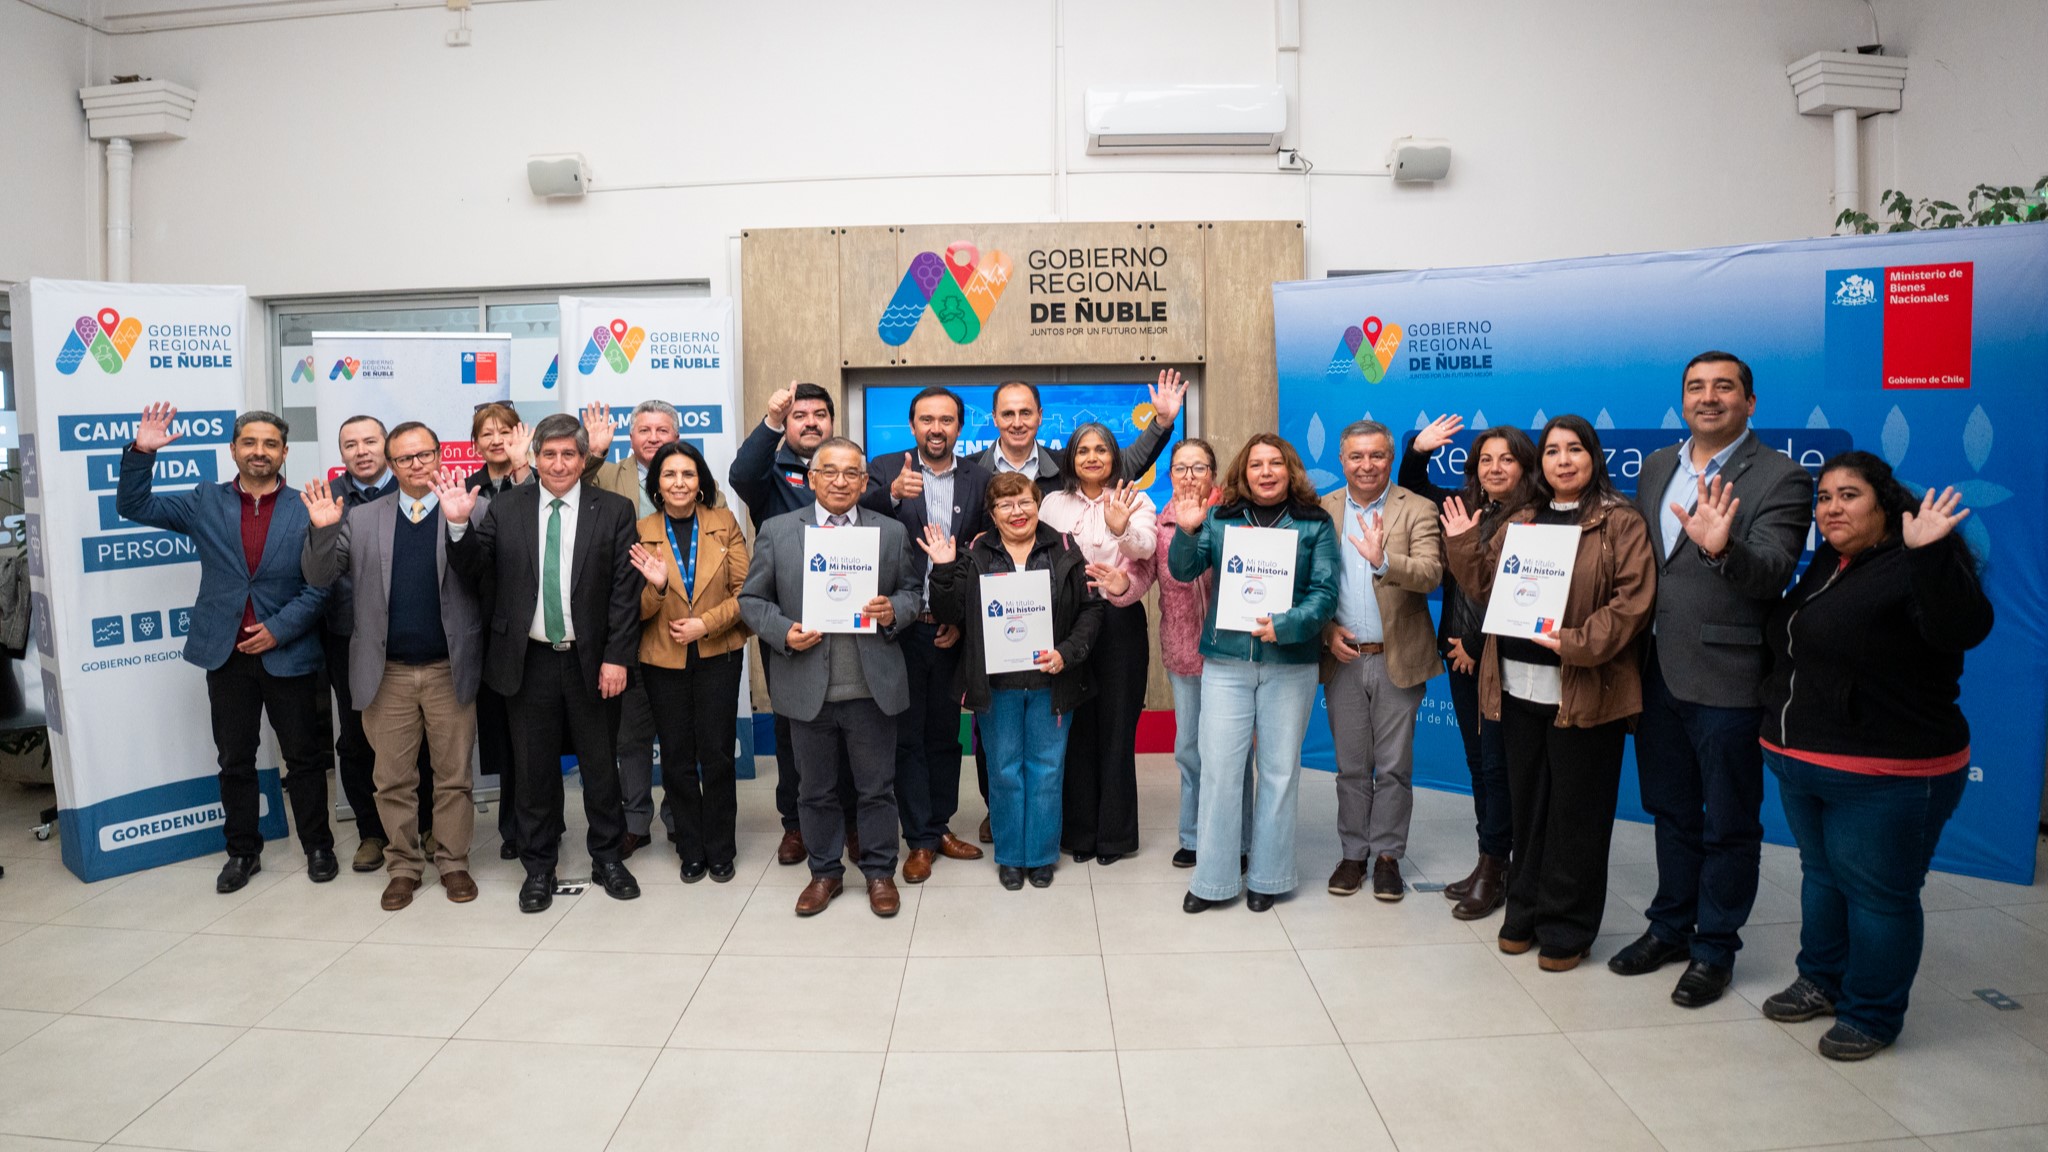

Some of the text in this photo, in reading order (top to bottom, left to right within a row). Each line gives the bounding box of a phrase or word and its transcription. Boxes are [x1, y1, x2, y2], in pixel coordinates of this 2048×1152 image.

[1028, 246, 1168, 270] GOBIERNO
[1890, 268, 1963, 281] Ministerio de
[1029, 271, 1167, 294] REGIONAL
[1890, 282, 1926, 293] Bienes
[1890, 293, 1949, 304] Nacionales
[1030, 297, 1167, 323] DE ÑUBLE
[148, 325, 232, 337] GOBIERNO
[1030, 326, 1168, 336] JUNTOS POR UN FUTURO MEJOR
[1408, 320, 1492, 337] GOBIERNO
[650, 332, 720, 343] GOBIERNO
[149, 339, 231, 351] REGIONAL
[650, 344, 719, 355] REGIONAL
[1408, 337, 1492, 353] REGIONAL
[150, 352, 232, 368] DE ÑUBLE
[651, 355, 720, 369] DE ÑUBLE
[1409, 352, 1493, 371] DE ÑUBLE
[373, 369, 394, 377] ÑUBLE
[1888, 375, 1965, 385] Gobierno de Chile
[97, 535, 197, 562] PERSON
[829, 563, 872, 571] Mi historia
[1524, 558, 1533, 566] Mi
[1246, 565, 1256, 573] Mi
[1257, 566, 1288, 576] historia
[1522, 565, 1532, 573] Mi
[1533, 566, 1566, 577] historia
[1017, 605, 1046, 613] historia
[81, 655, 142, 673] GOBIERNO
[112, 807, 226, 842] GOREDENUBL
